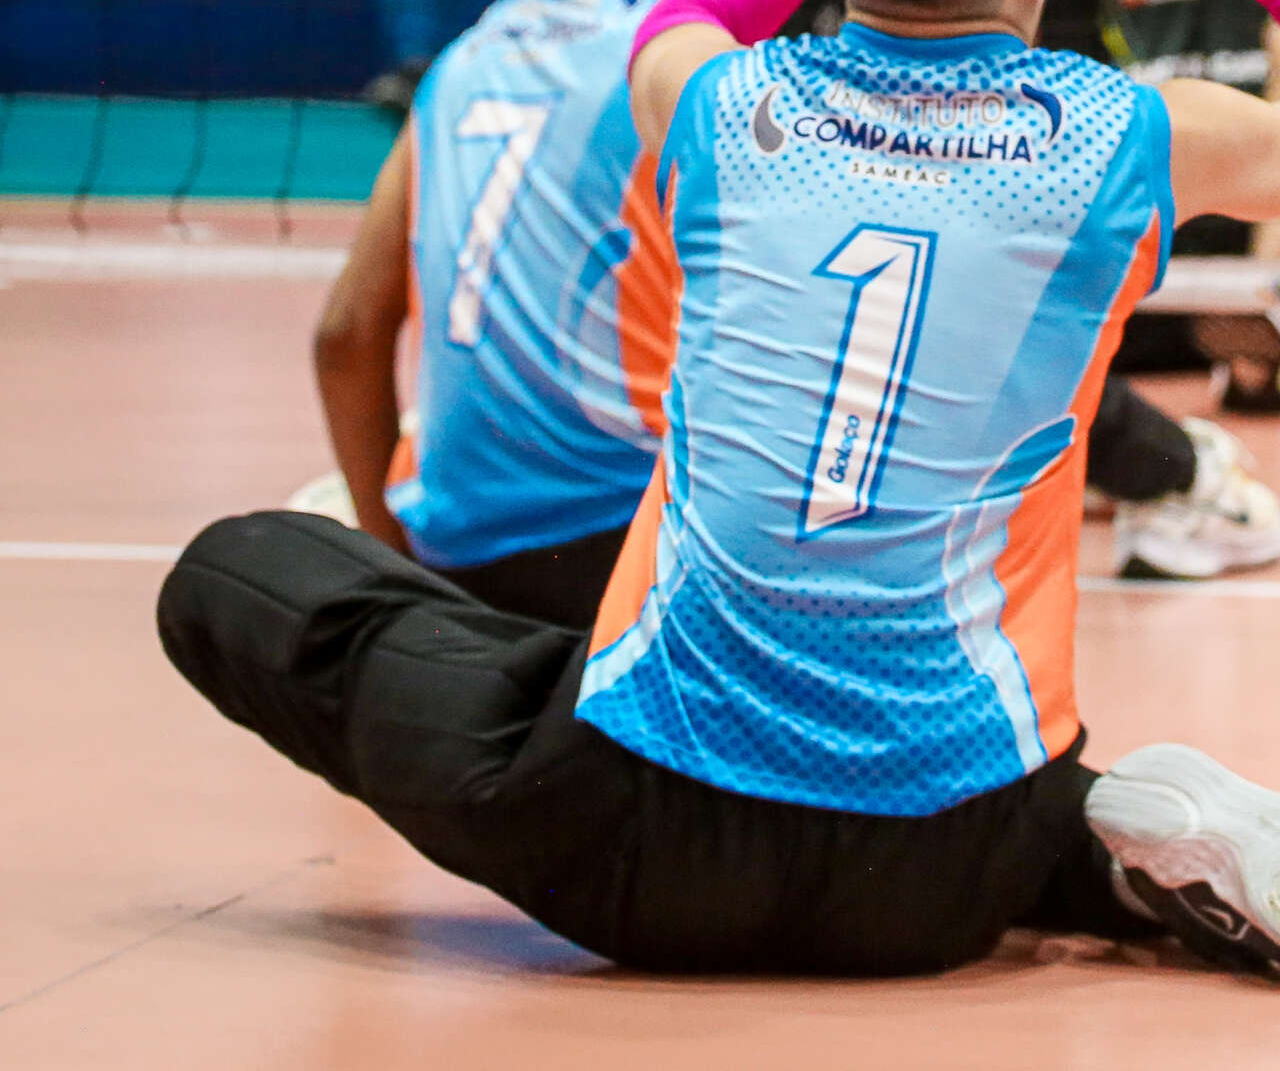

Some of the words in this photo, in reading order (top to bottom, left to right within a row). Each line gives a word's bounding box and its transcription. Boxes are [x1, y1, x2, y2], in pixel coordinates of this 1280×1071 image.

[793, 115, 1032, 164] COMPARTILHA
[825, 79, 1006, 128] INSTITUTO
[448, 92, 557, 350] 7
[795, 222, 938, 544] 1
